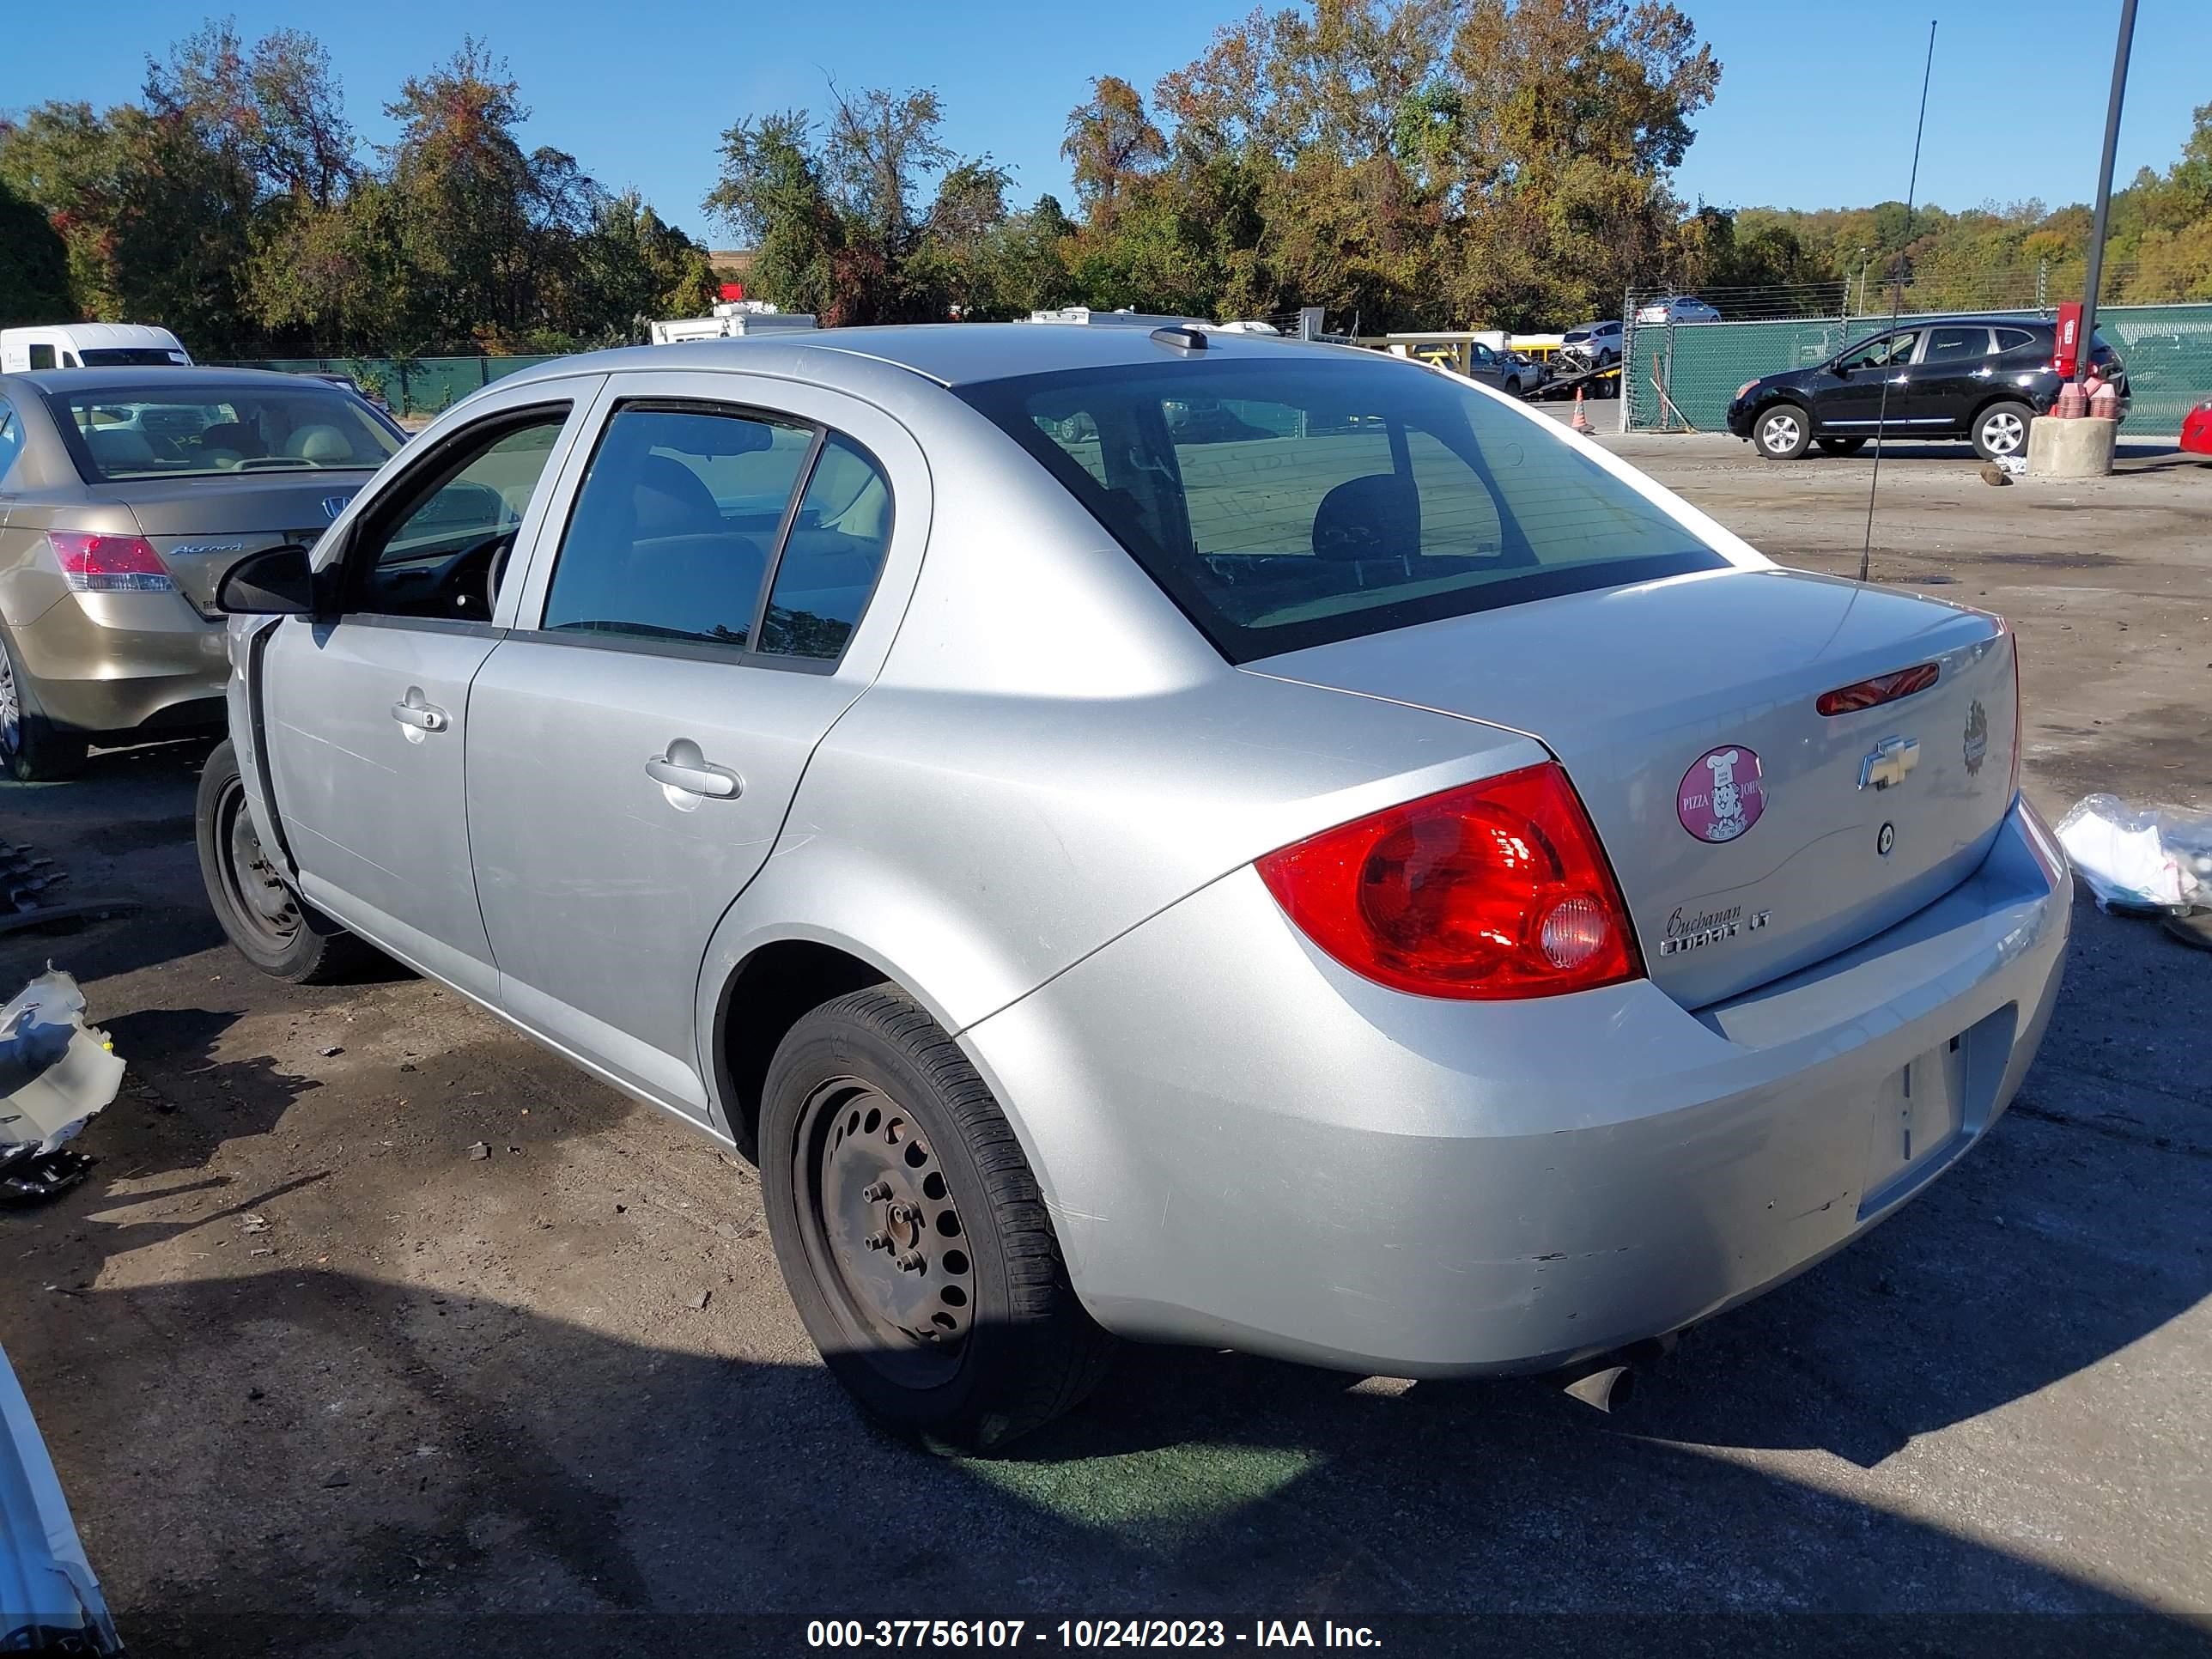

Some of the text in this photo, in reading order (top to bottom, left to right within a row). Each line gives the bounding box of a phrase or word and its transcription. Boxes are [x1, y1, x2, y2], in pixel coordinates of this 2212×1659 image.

[169, 542, 242, 556] Accord
[1683, 794, 1709, 811] PIZZA
[1667, 906, 1741, 938] Buchanan
